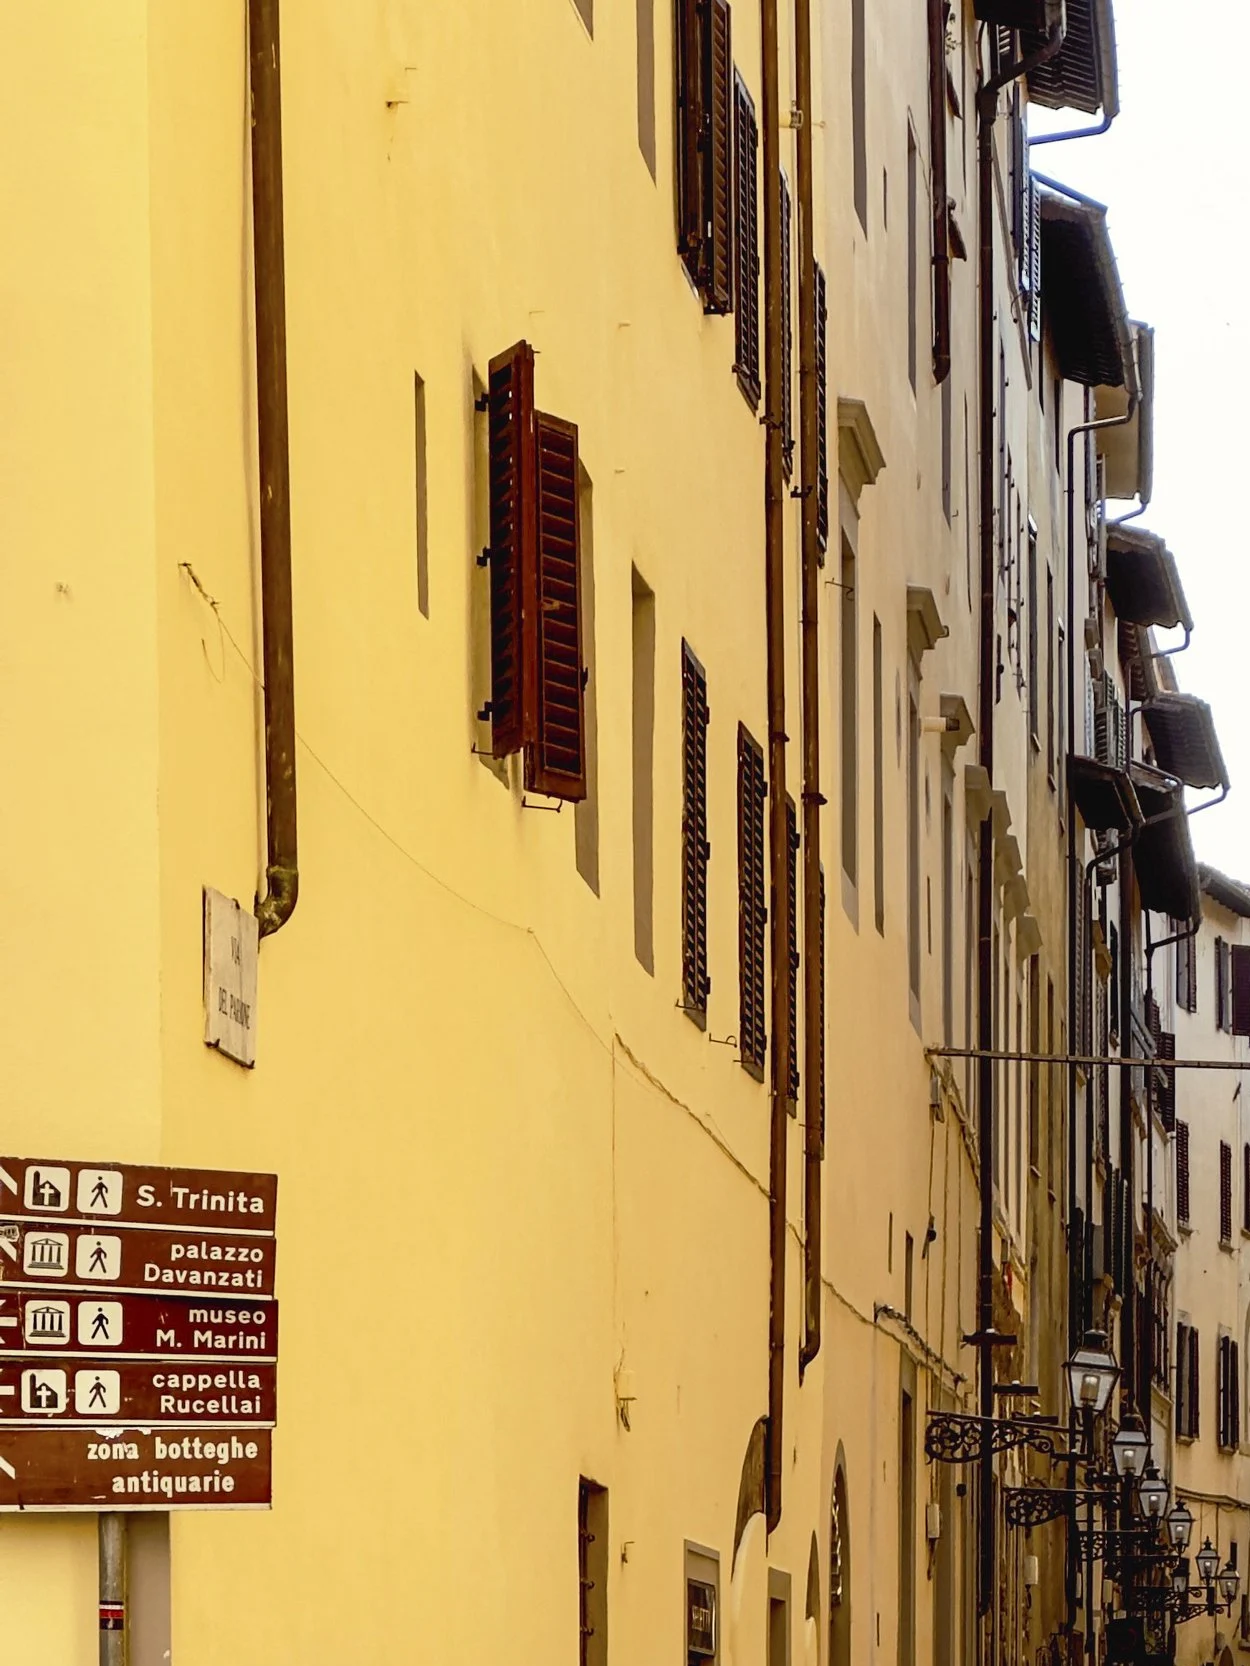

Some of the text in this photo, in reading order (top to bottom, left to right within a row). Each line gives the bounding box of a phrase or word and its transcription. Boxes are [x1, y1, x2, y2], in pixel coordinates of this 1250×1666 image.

[136, 1184, 264, 1214] S. Trinita
[170, 1241, 264, 1263] palazzo
[143, 1263, 263, 1289] Davanzati
[188, 1308, 266, 1325] museo
[156, 1329, 266, 1350] M. Marini
[152, 1370, 261, 1392] cappella
[160, 1395, 262, 1415] Rucellai
[87, 1436, 259, 1465] zona botteghe
[112, 1470, 235, 1499] antiquarie
